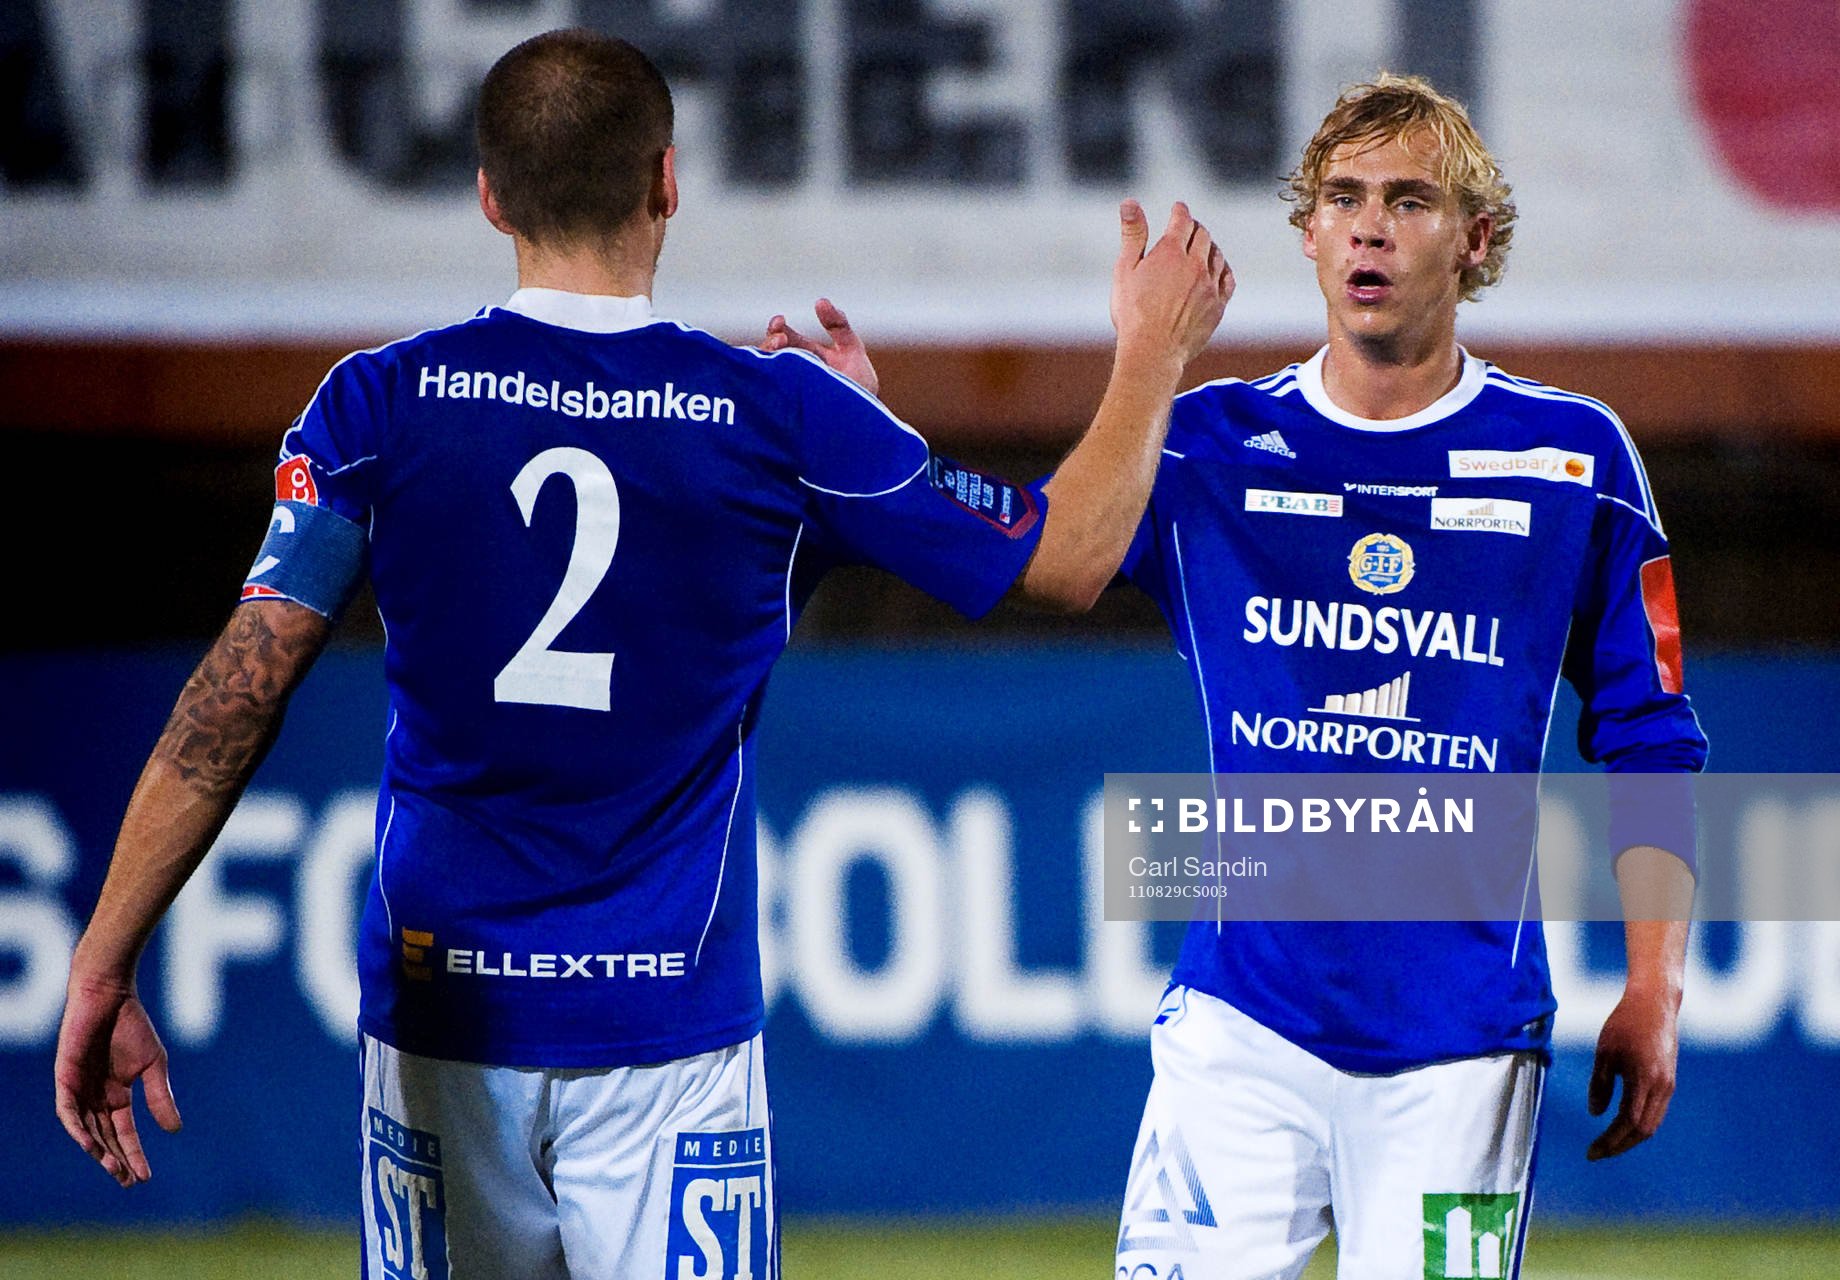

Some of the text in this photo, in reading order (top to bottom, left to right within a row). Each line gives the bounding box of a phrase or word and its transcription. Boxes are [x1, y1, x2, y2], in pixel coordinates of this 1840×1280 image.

[418, 364, 735, 426] Handelsbanken
[1260, 495, 1329, 512] PEAB
[1357, 484, 1439, 497] INTERSPORT
[1434, 517, 1526, 532] NORRPORTEN
[493, 446, 620, 712] 2
[1243, 595, 1504, 667] SUNDSVALL
[1231, 710, 1499, 772] NORRPORTEN
[446, 949, 685, 978] ELLEXTRE
[373, 1116, 437, 1158] MEDIE
[684, 1137, 761, 1157] MEDIE
[378, 1155, 437, 1280] ST
[678, 1175, 761, 1280] ST
